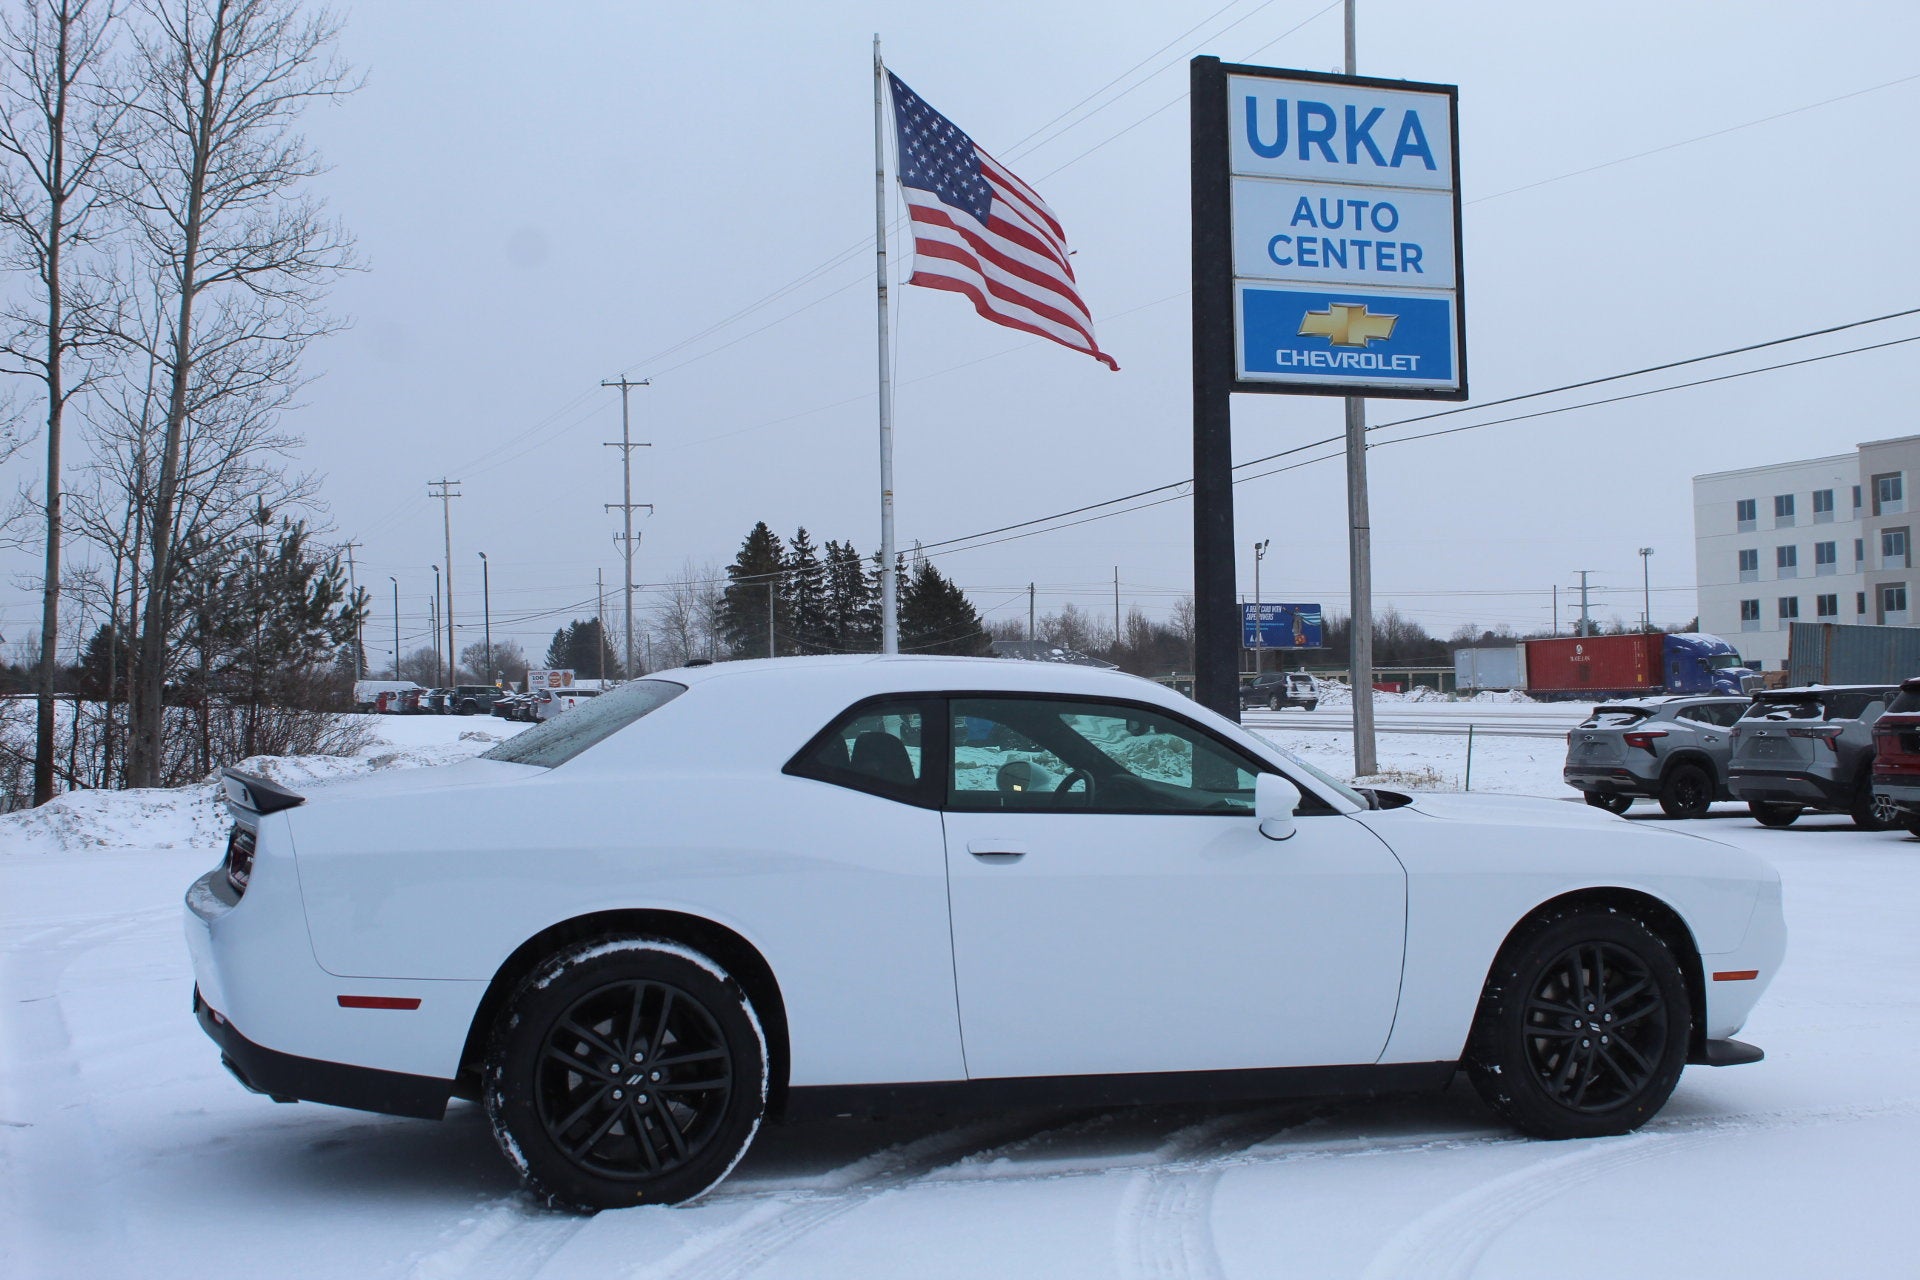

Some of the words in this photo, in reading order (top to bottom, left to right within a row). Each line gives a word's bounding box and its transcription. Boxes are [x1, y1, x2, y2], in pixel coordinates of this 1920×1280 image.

[1245, 95, 1437, 171] URKA
[1290, 196, 1399, 233] AUTO
[1267, 234, 1424, 274] CENTER
[1276, 349, 1421, 371] CHEVROLET
